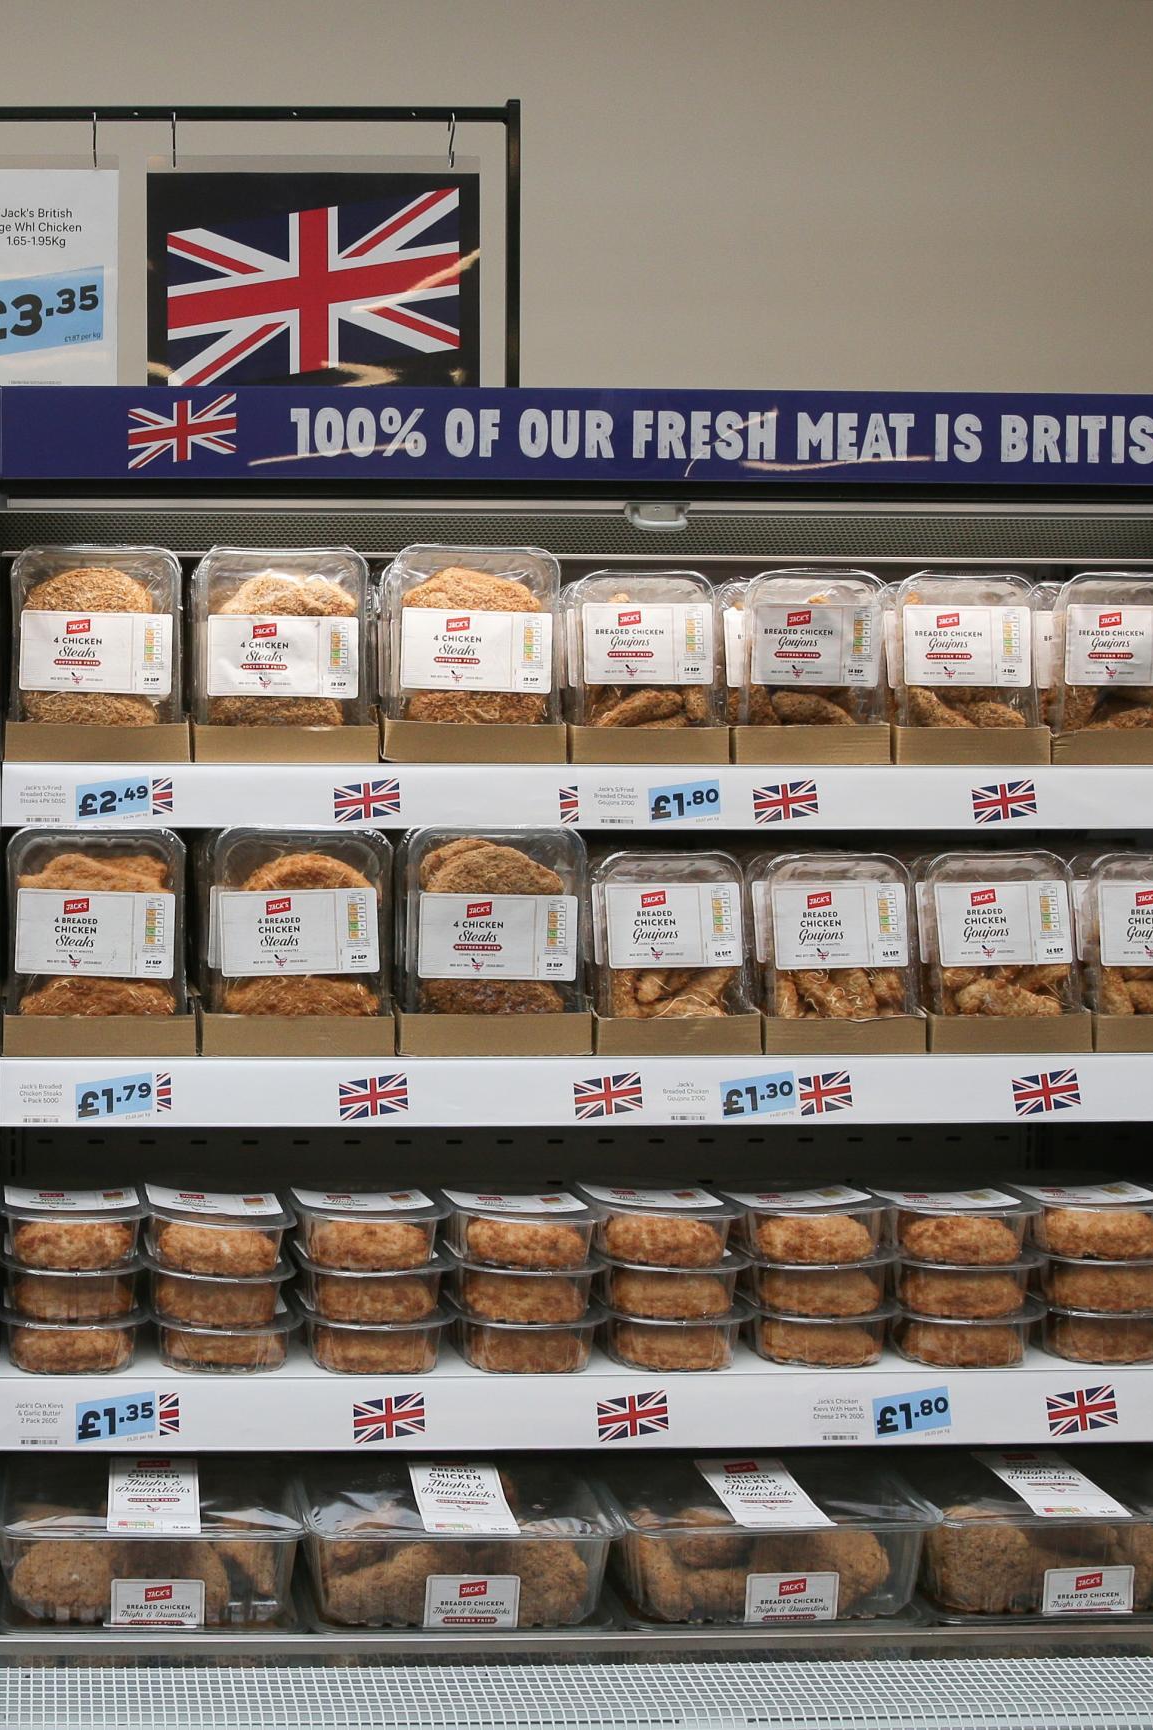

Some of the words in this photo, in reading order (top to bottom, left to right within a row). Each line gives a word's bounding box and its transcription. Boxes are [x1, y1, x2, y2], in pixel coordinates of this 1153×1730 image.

[0, 208, 35, 218] Jack's
[38, 208, 73, 218] British
[15, 222, 35, 232] Whl
[38, 222, 82, 232] Chicken
[6, 236, 66, 248] 1.65-1.95Kg
[80, 334, 91, 342] per
[290, 408, 427, 458] 100%
[444, 408, 502, 458] OF
[519, 410, 615, 459] OUR
[632, 411, 776, 460] FRESH
[797, 412, 913, 462] MEAT
[936, 414, 983, 463] IS
[1000, 414, 1153, 465] BRITIS
[619, 614, 640, 622] JACK'S
[68, 623, 89, 631] JACK'S
[53, 637, 59, 645] 4
[62, 637, 103, 645] CHICKEN
[610, 635, 650, 650] Goujons
[59, 646, 96, 658] Steaks
[78, 785, 149, 817] £2.49
[651, 788, 719, 820] £1.80
[643, 895, 664, 904] JACK'S
[66, 901, 88, 911] JACK'S
[634, 918, 676, 926] CHICKEN
[54, 925, 97, 934] CHICKEN
[55, 934, 95, 947] Steaks
[633, 927, 680, 944] Goujons
[77, 1082, 152, 1118] £1.79
[723, 1080, 794, 1116] £1.30
[77, 1401, 154, 1440] £1.35
[876, 1396, 949, 1435] £1.80
[125, 1478, 167, 1487] Thighs
[1078, 1578, 1100, 1587] JACK'S
[461, 1585, 485, 1594] JACK'S
[1051, 1600, 1074, 1609] Thighs
[432, 1606, 457, 1615] Thighs
[468, 1606, 511, 1615] Drumsticks
